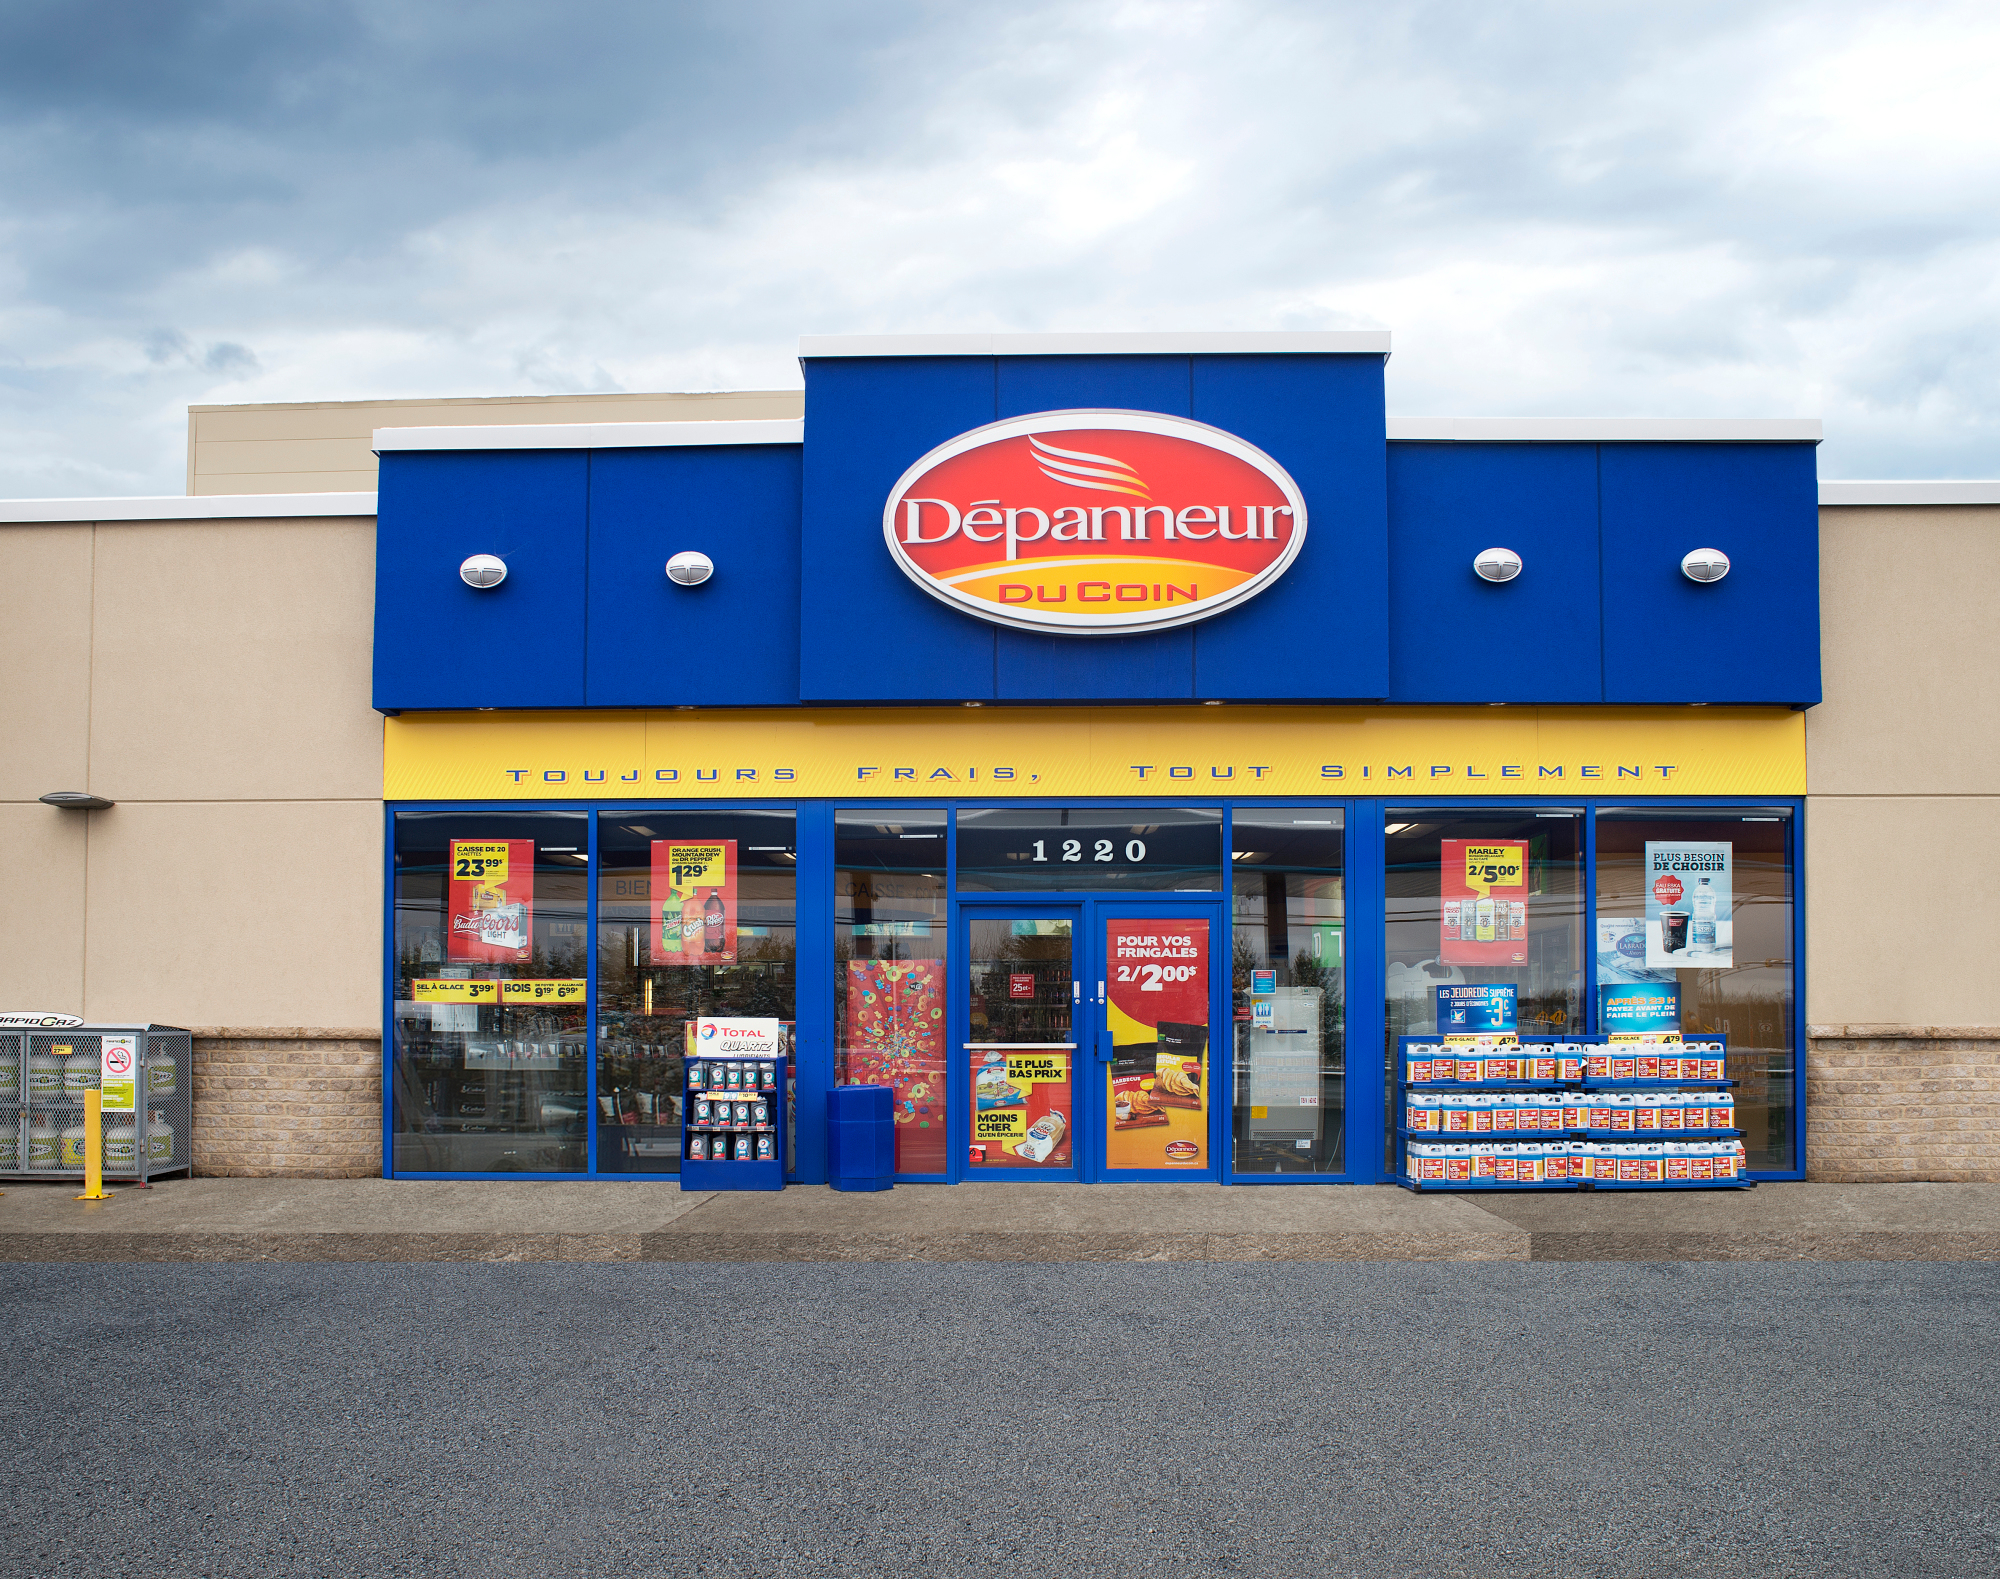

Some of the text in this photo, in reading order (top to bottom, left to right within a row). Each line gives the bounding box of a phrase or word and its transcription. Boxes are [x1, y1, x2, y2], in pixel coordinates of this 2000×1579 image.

[901, 498, 1293, 560] Dépanneur
[999, 581, 1198, 602] DU COIN
[506, 764, 1678, 784] TOUJOURS FRAIS, TOUT SIMPLEMENT
[1033, 839, 1146, 862] 1220
[1653, 853, 1725, 861] PLUS BESOIN
[1653, 862, 1725, 871] DE CHOISIR
[482, 914, 519, 931] Coors
[683, 917, 704, 937] Crush
[487, 931, 507, 939] LIGHT
[1117, 936, 1191, 946] POUR VOS
[1117, 948, 1198, 957] FRINGALES
[504, 983, 531, 992] BOIS
[1013, 983, 1023, 992] 25
[1440, 987, 1514, 998] LES JEUDREDIS SUPRÊME
[1607, 996, 1645, 1005] APRÈS
[721, 1027, 765, 1038] TOTAL
[720, 1040, 773, 1052] QUARTZ
[1009, 1060, 1053, 1068] LE PLUS
[1009, 1070, 1062, 1078] BAS PRIX
[977, 1114, 1018, 1122] MOINS
